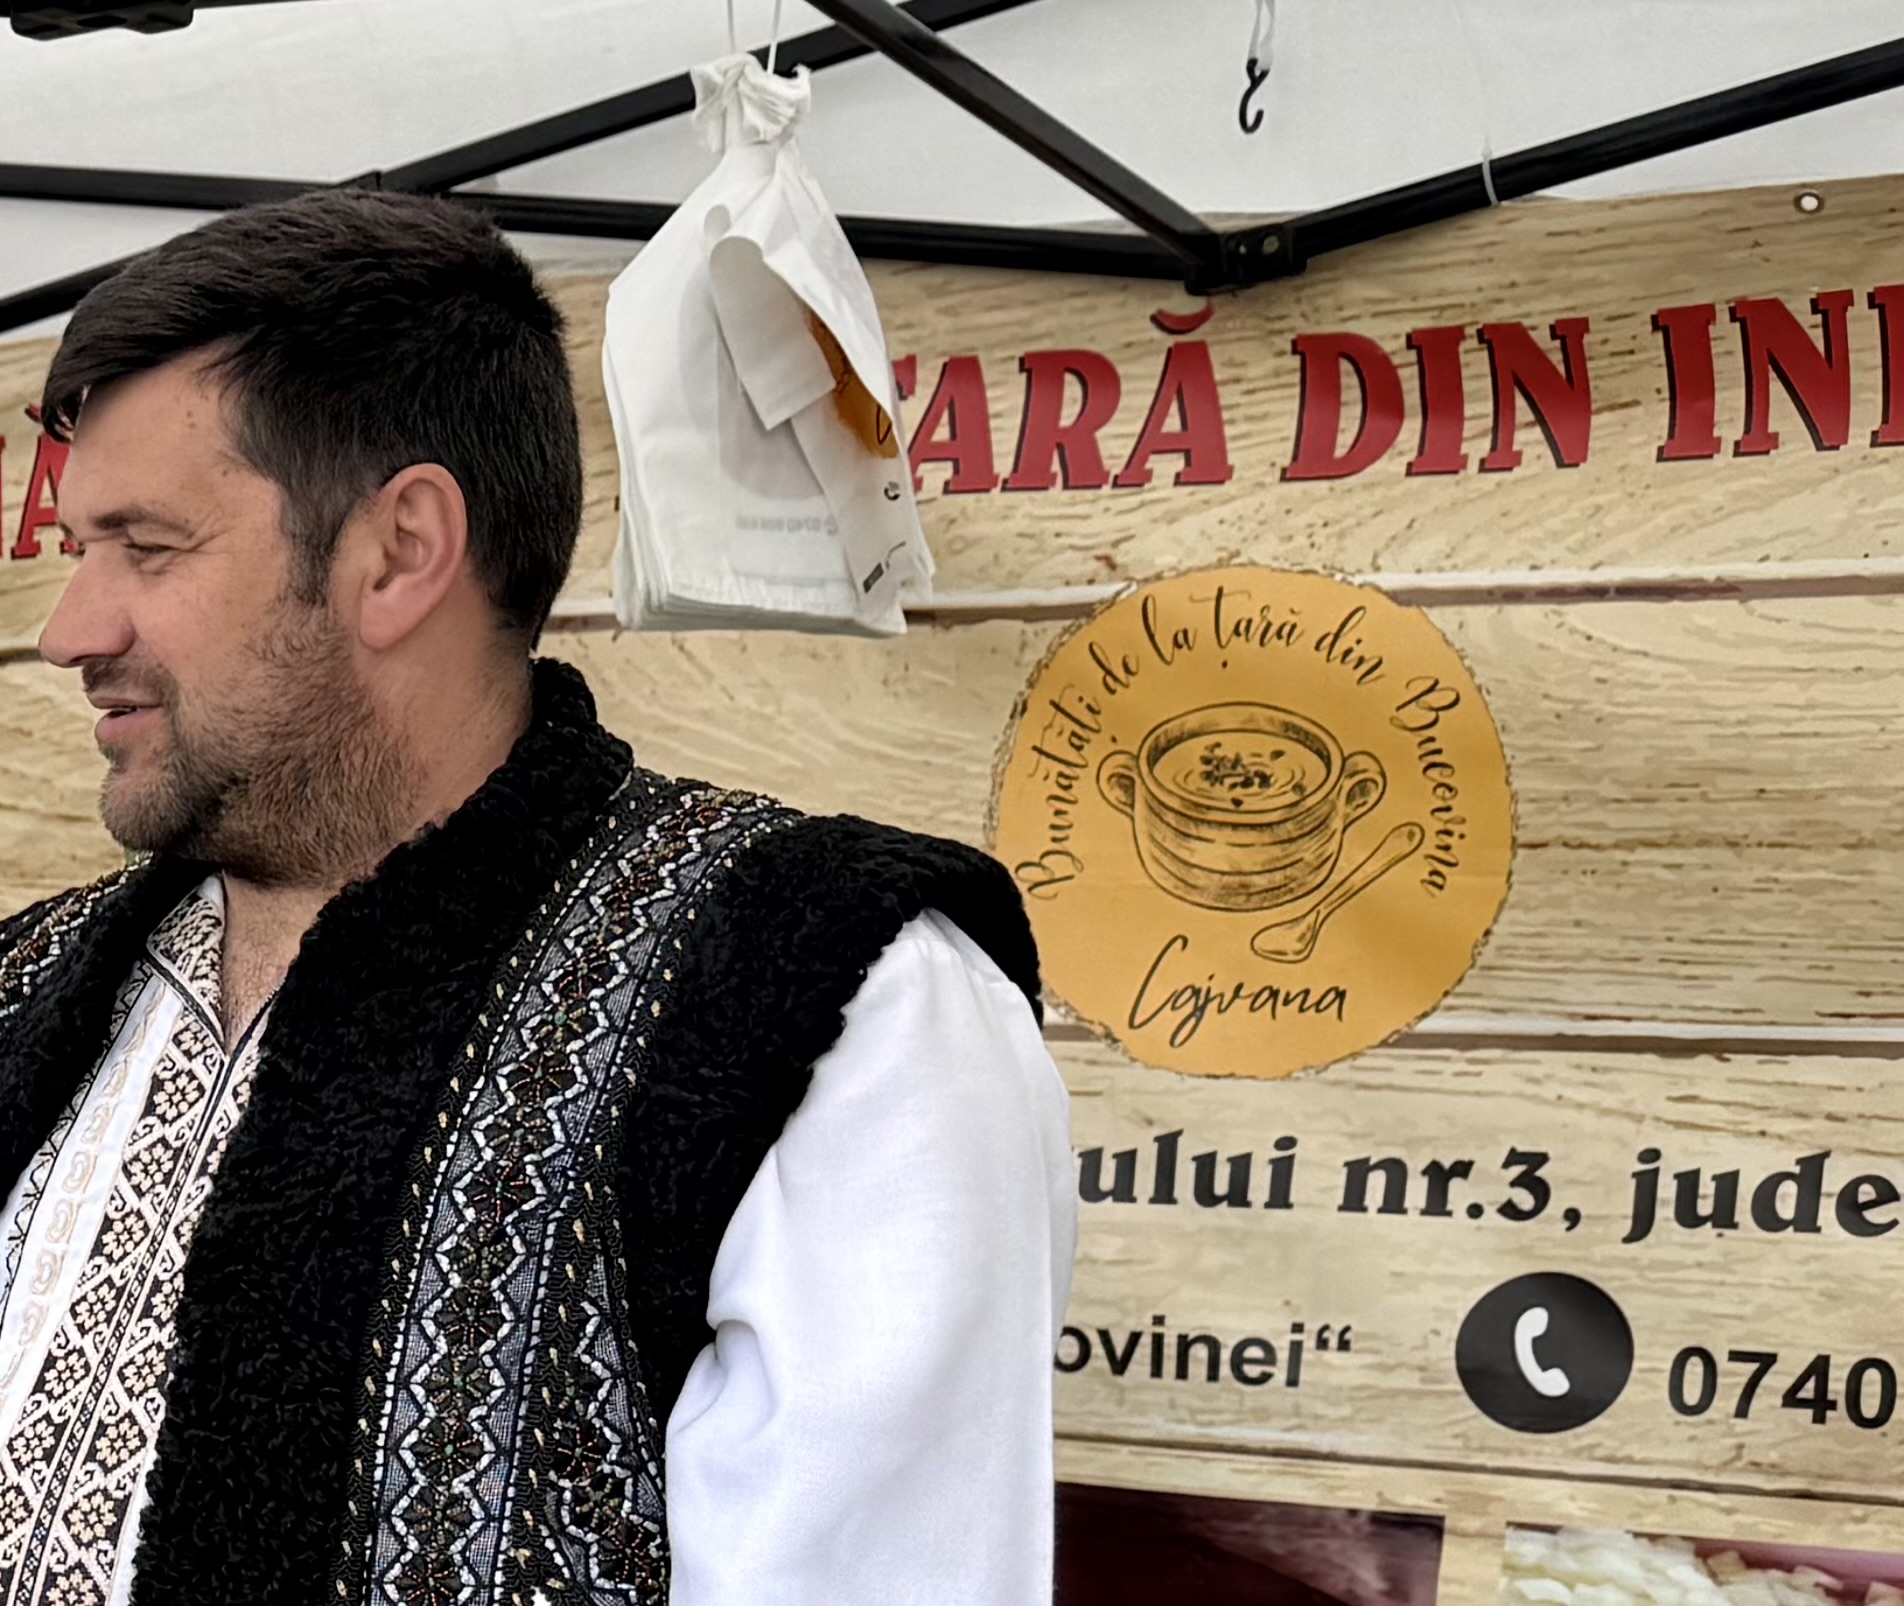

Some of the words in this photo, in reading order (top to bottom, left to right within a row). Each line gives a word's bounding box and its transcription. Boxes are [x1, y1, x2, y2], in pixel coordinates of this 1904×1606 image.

[888, 300, 1233, 494] ARĂ
[1281, 317, 1590, 484] DIN
[1090, 641, 1141, 697] de
[1141, 595, 1197, 667] la
[1314, 605, 1387, 686] din
[1390, 675, 1468, 899] Bucovina
[1337, 1146, 1584, 1232] nr.3,
[1667, 1344, 1898, 1430] 0740
